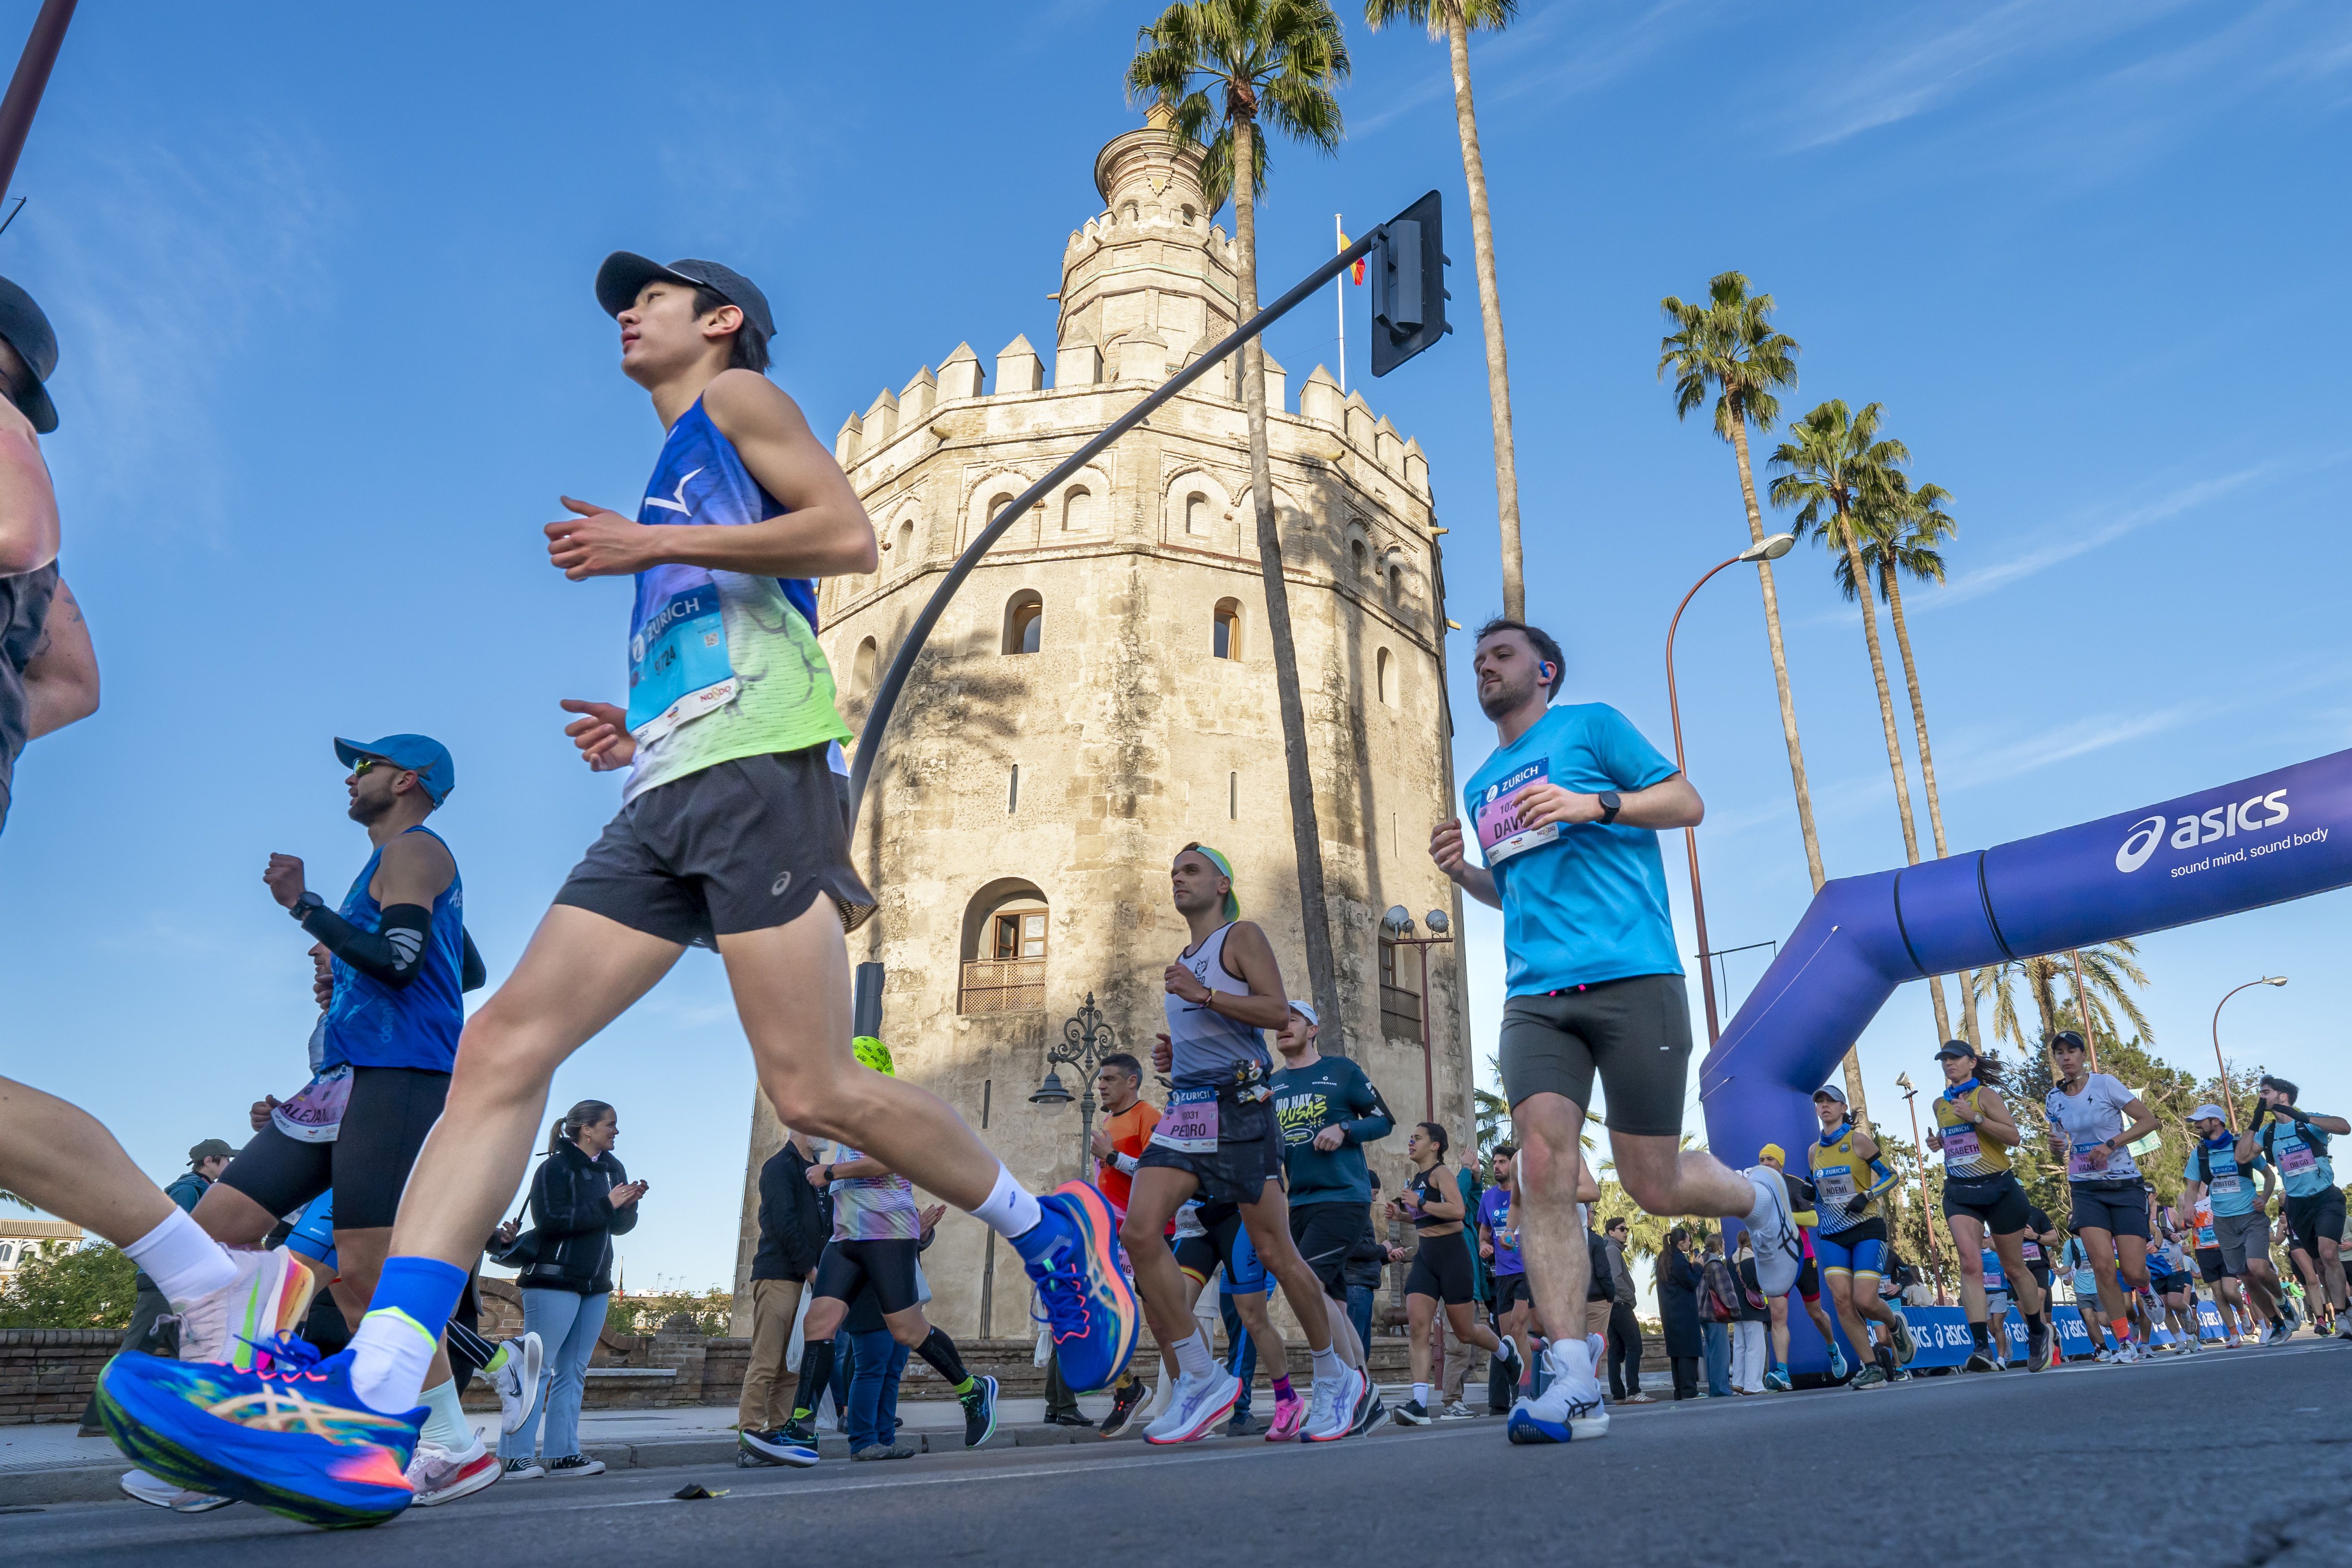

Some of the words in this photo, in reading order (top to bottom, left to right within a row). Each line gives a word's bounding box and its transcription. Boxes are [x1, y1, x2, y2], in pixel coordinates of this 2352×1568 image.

[645, 598, 700, 641] ZURICH
[654, 645, 676, 675] 9724
[1502, 766, 1538, 792] ZURICH
[2170, 788, 2289, 849] asics
[2171, 857, 2209, 877] sound
[2213, 849, 2247, 868] mind,
[2250, 839, 2291, 857] sound
[2294, 827, 2329, 845] body
[1181, 1091, 1210, 1101] ZURICH
[1275, 1097, 1289, 1112] NO
[1291, 1093, 1312, 1109] HAY
[1170, 1123, 1206, 1137] PEDRO
[1948, 1126, 1969, 1134] ZURICH
[2287, 1144, 2306, 1152] ZURICH
[2289, 1159, 2309, 1169] DIEGO
[1826, 1184, 1847, 1195] NOEMÍ
[1943, 1324, 1971, 1345] asics
